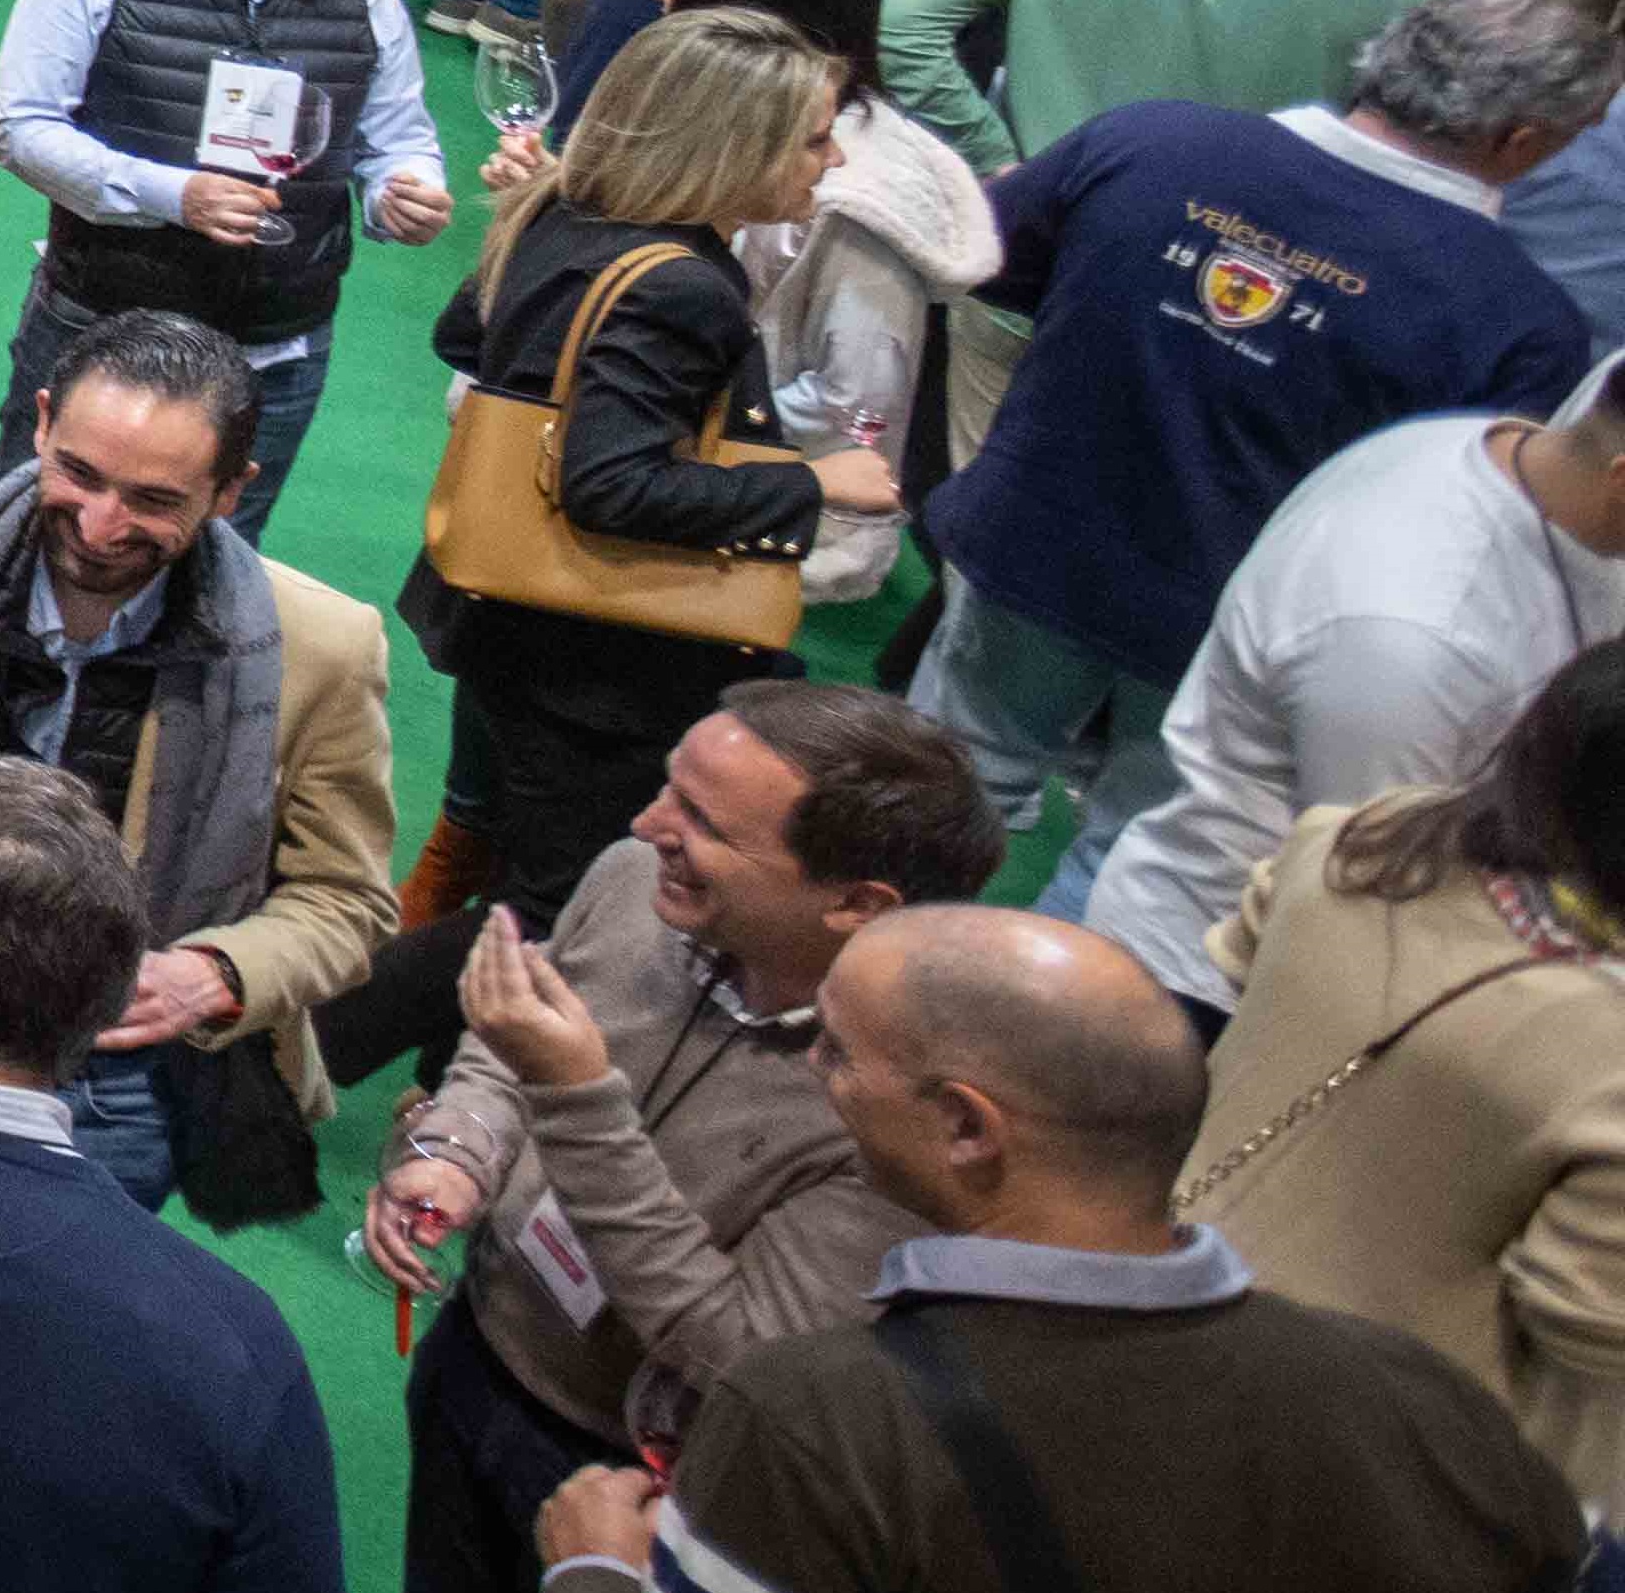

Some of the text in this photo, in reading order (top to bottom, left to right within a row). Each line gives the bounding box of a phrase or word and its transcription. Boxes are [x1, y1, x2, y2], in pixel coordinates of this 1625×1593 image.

[1163, 243, 1197, 268] 19
[1185, 200, 1367, 295] valecuatro
[1288, 303, 1325, 331] 71
